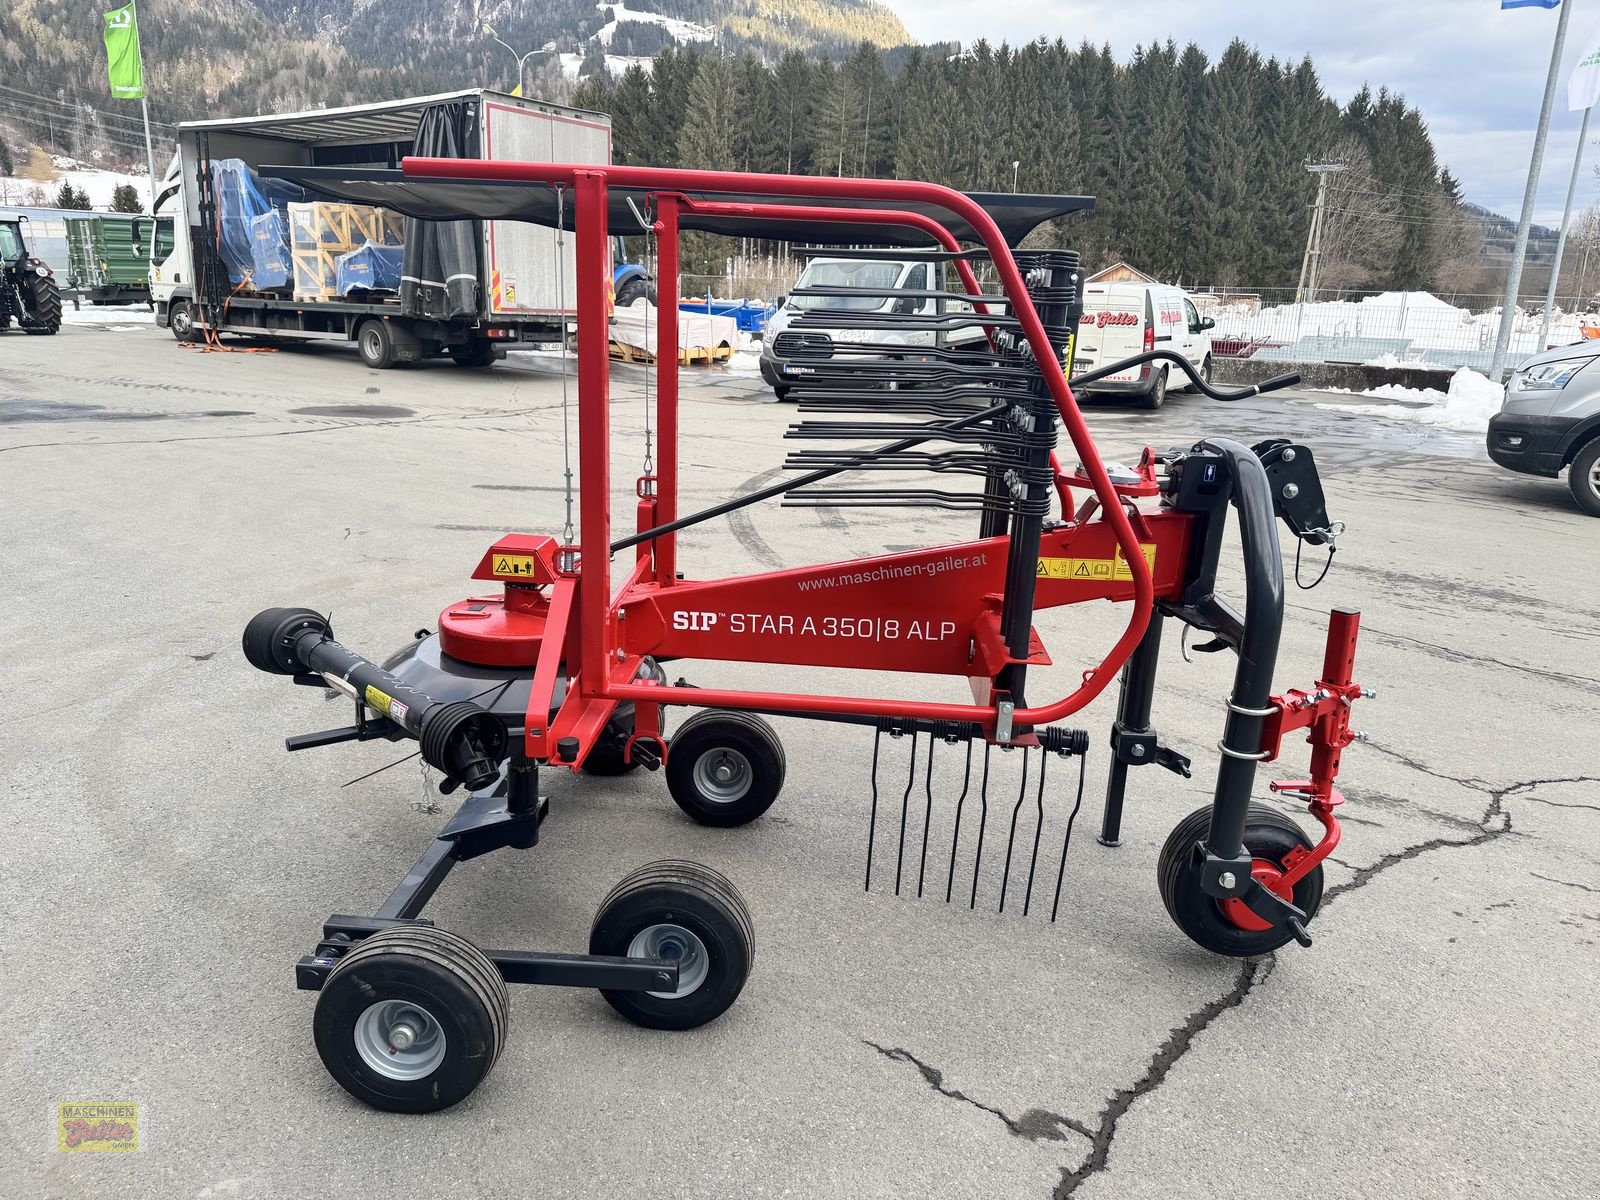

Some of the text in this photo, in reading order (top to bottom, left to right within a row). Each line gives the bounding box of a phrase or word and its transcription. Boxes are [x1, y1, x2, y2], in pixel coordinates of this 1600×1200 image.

[1097, 311, 1139, 328] Gailer
[798, 553, 988, 592] www.maschinen-gailer.at
[730, 613, 794, 635] STAR
[800, 616, 817, 636] A
[906, 620, 956, 641] ALP
